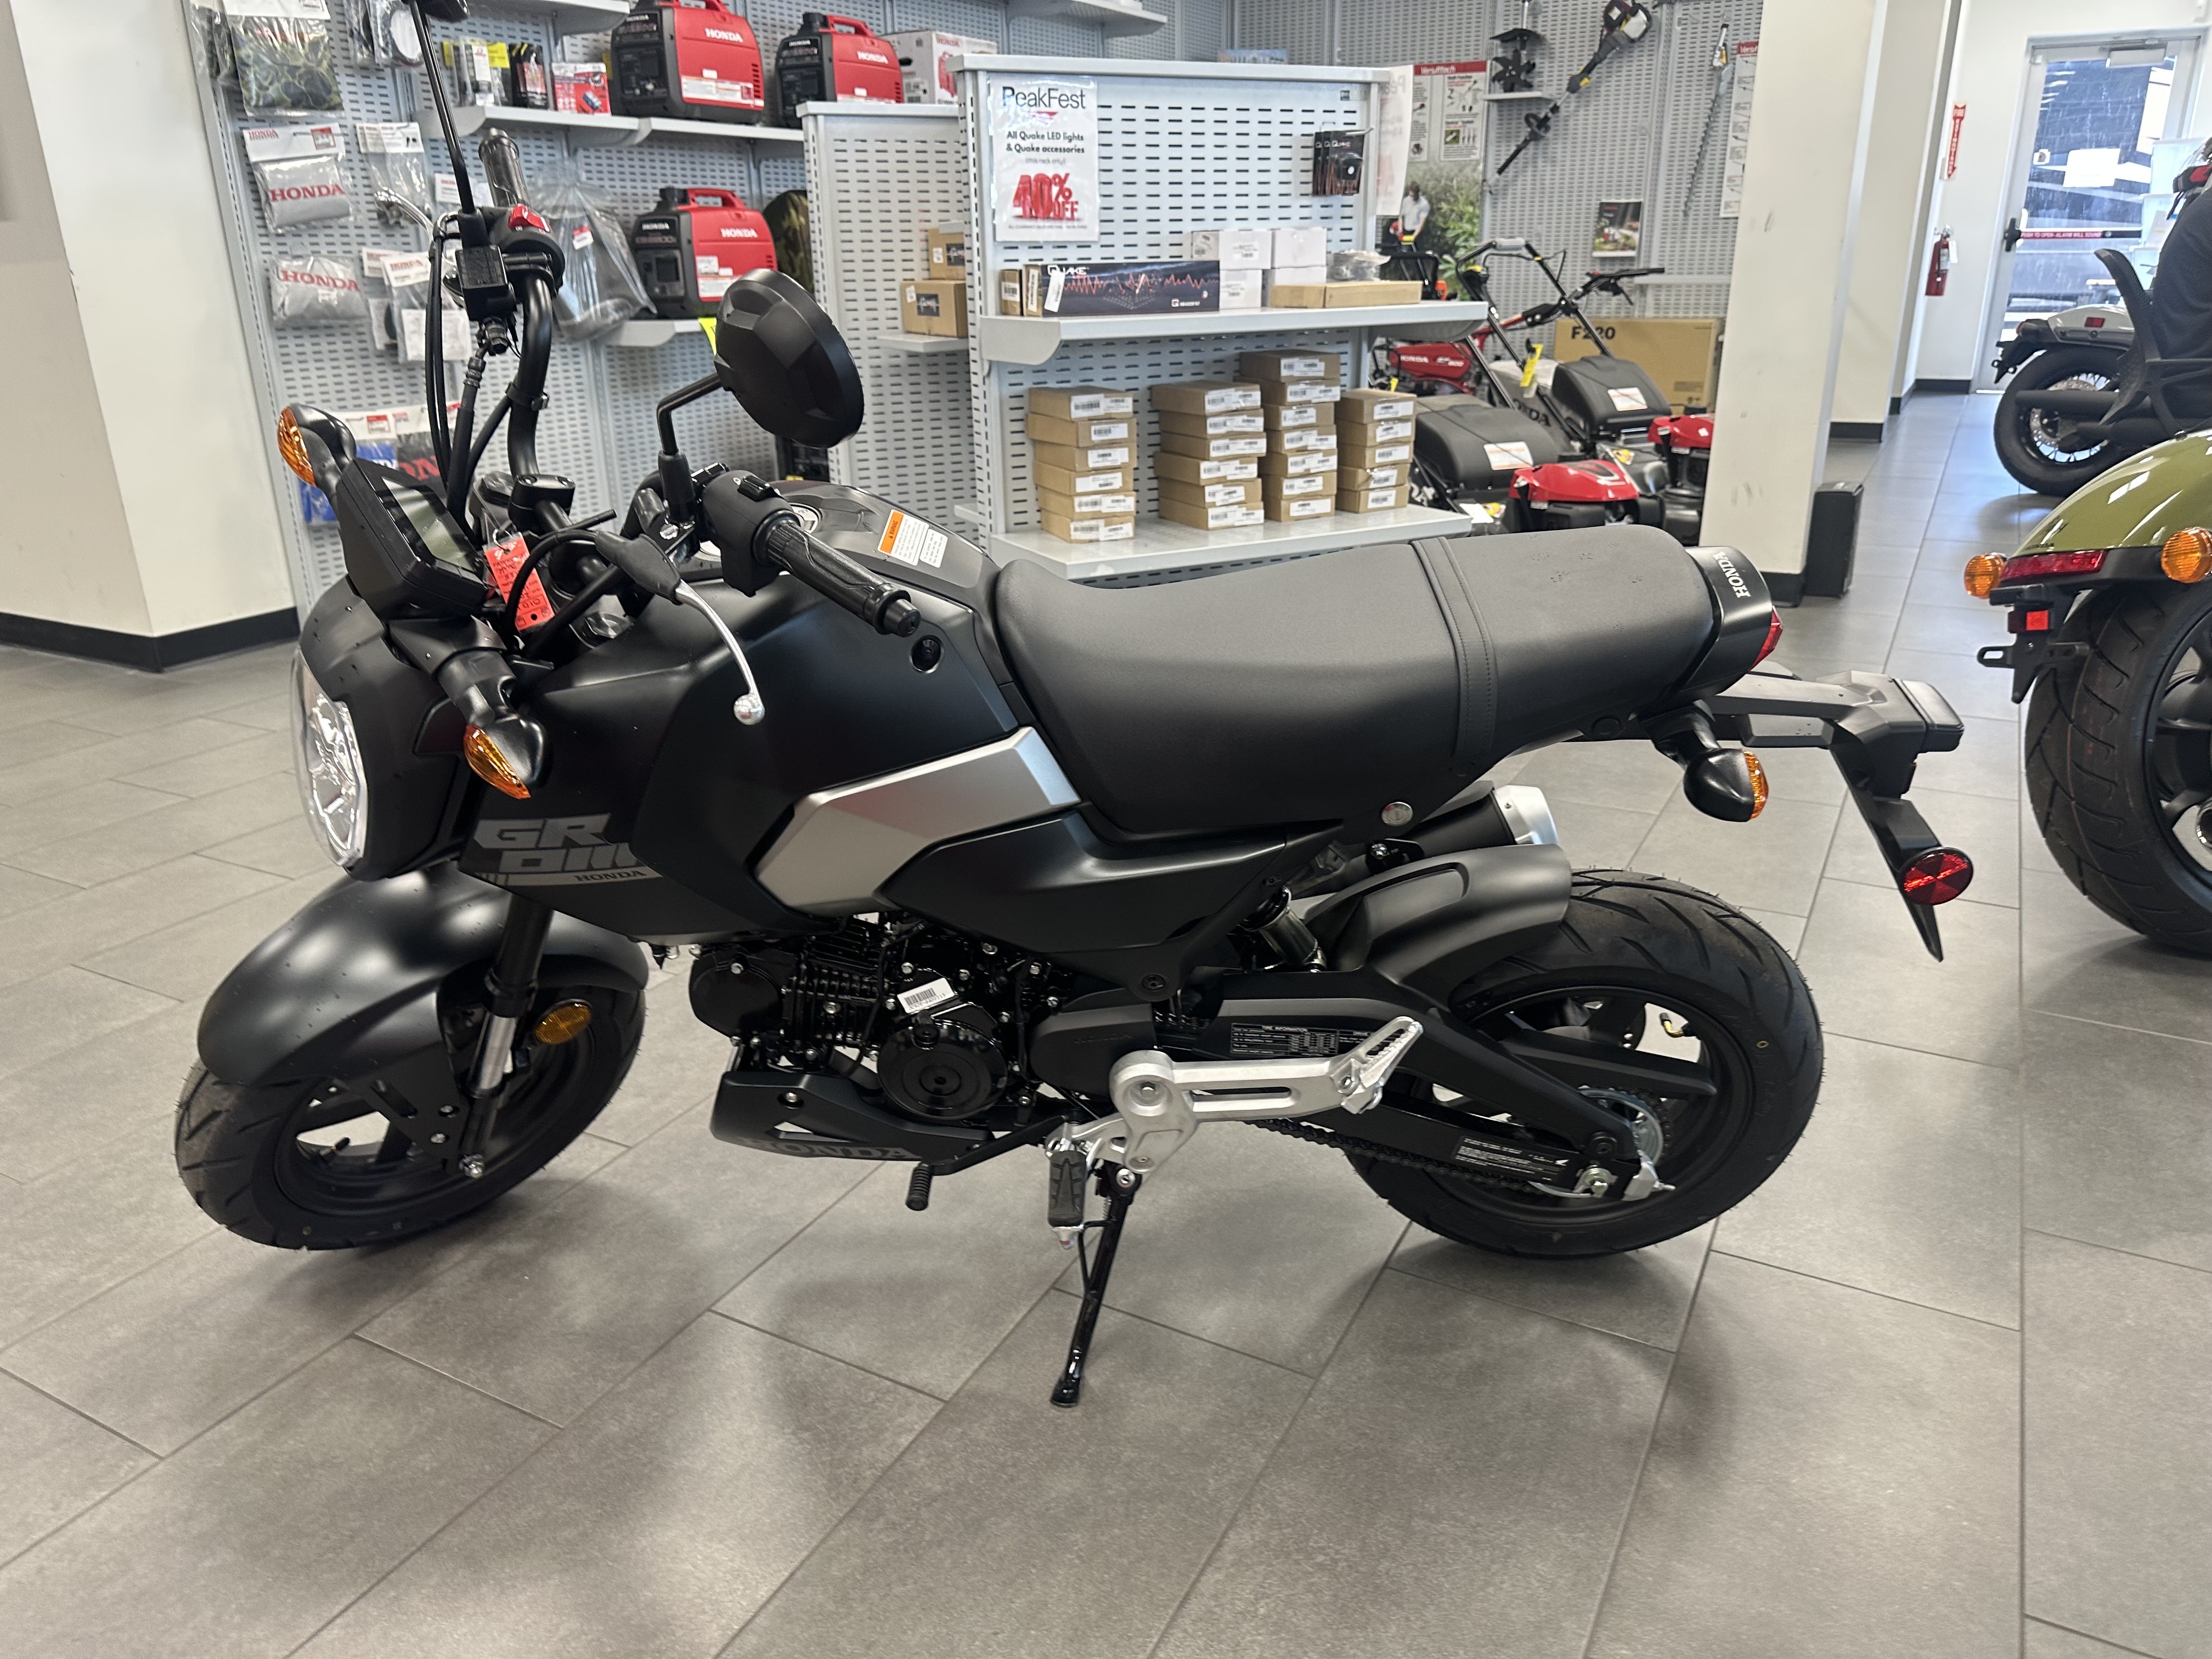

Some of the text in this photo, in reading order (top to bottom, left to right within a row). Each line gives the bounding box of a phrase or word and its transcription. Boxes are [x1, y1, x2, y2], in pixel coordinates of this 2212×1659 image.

[705, 27, 743, 42] HONDA
[857, 50, 889, 64] HONDA
[1002, 86, 1086, 109] PeakFest
[1019, 131, 1045, 140] Quake
[1047, 132, 1061, 140] LED
[1063, 133, 1084, 143] lights
[1014, 144, 1040, 153] Quake
[1042, 145, 1085, 154] accessories
[269, 184, 346, 202] HONDA
[1013, 173, 1073, 219] 40%
[720, 228, 758, 238] HONDA
[280, 269, 360, 292] HONDA
[1712, 551, 1751, 598] HONDA
[473, 812, 612, 849] GR
[575, 870, 647, 882] HONDA
